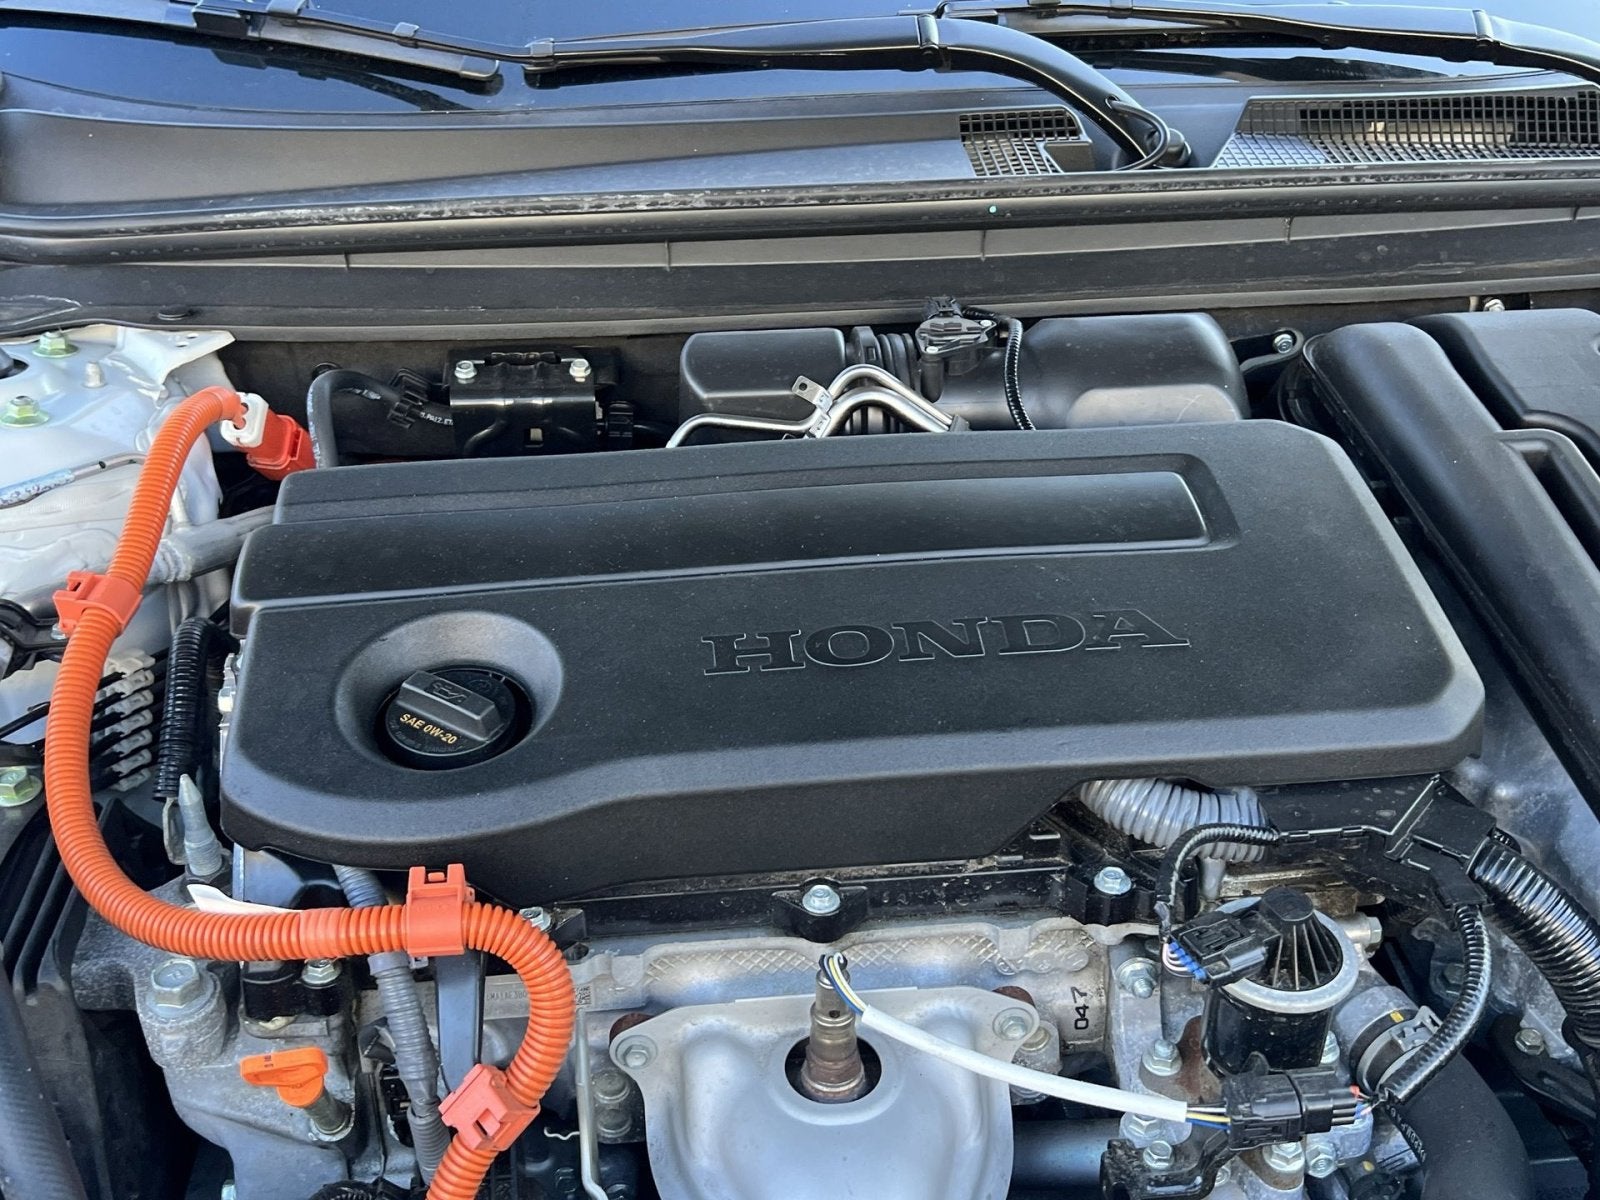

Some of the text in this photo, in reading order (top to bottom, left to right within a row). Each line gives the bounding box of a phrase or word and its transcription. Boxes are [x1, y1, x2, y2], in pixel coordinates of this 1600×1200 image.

[700, 608, 1191, 676] HONDA
[399, 713, 425, 729] SAE
[423, 724, 457, 744] 0W-20
[1070, 986, 1090, 1030] 047
